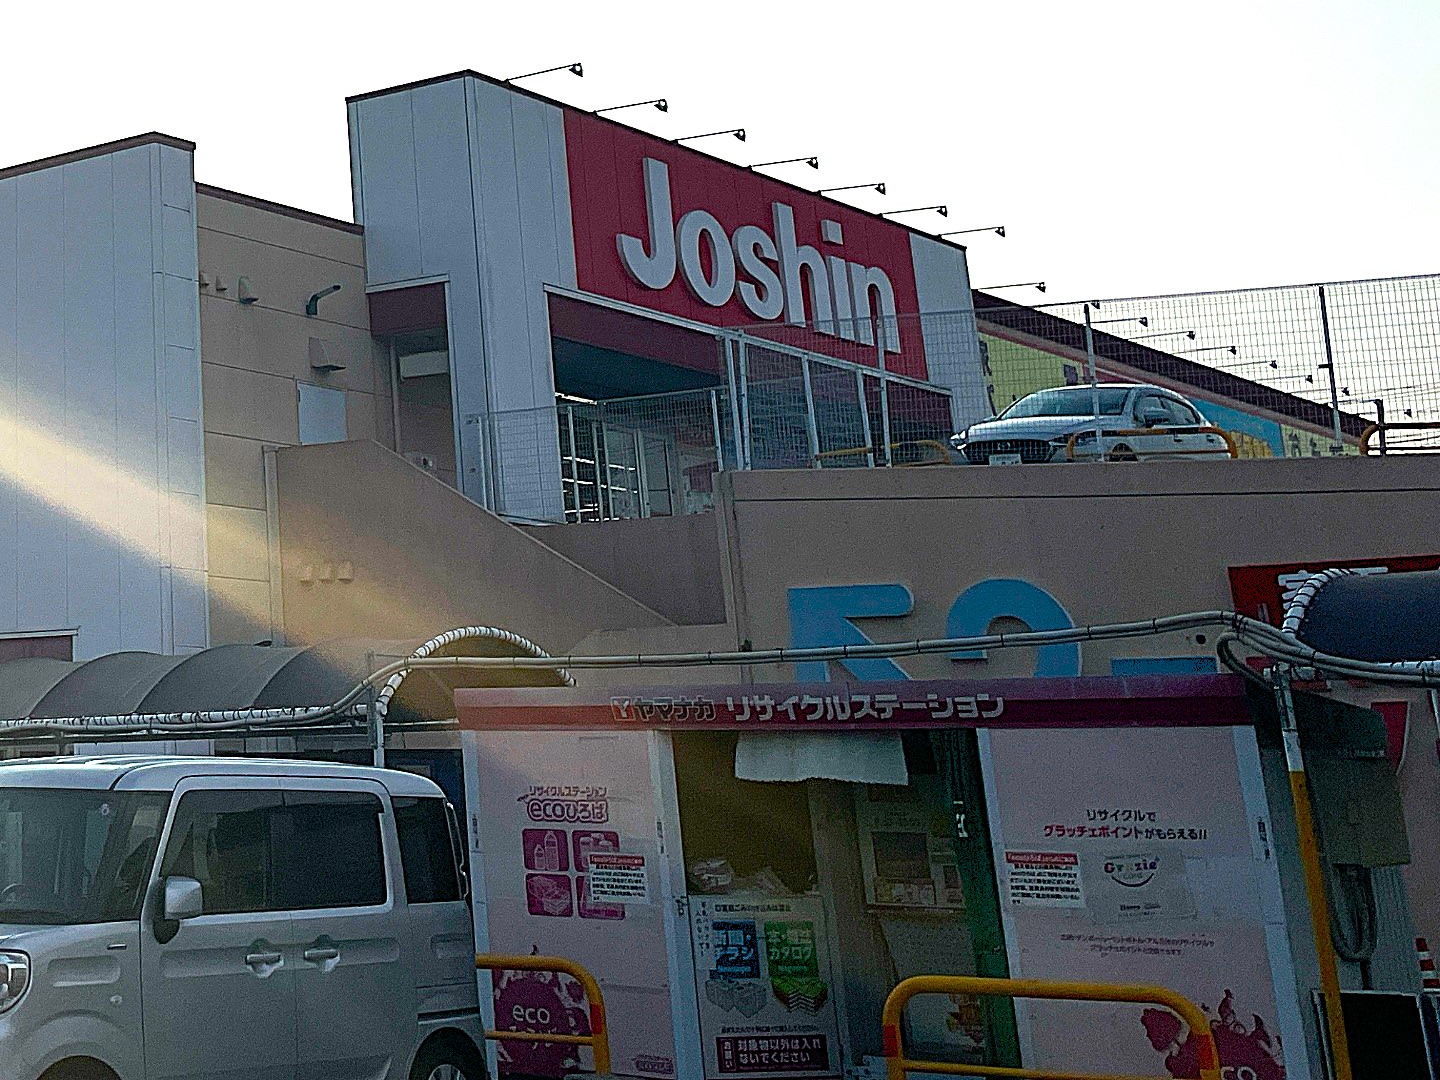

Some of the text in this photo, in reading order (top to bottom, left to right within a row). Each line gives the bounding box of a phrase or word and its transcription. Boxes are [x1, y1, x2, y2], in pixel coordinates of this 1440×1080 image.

[616, 157, 901, 354] Joshin
[725, 694, 1004, 721] リサイクルステーション
[529, 786, 607, 798] リサイクルステーション
[528, 800, 608, 822] ecoひろば
[1086, 808, 1157, 822] リサイクルで
[512, 1004, 551, 1024] eco
[739, 1052, 811, 1064] ないでください
